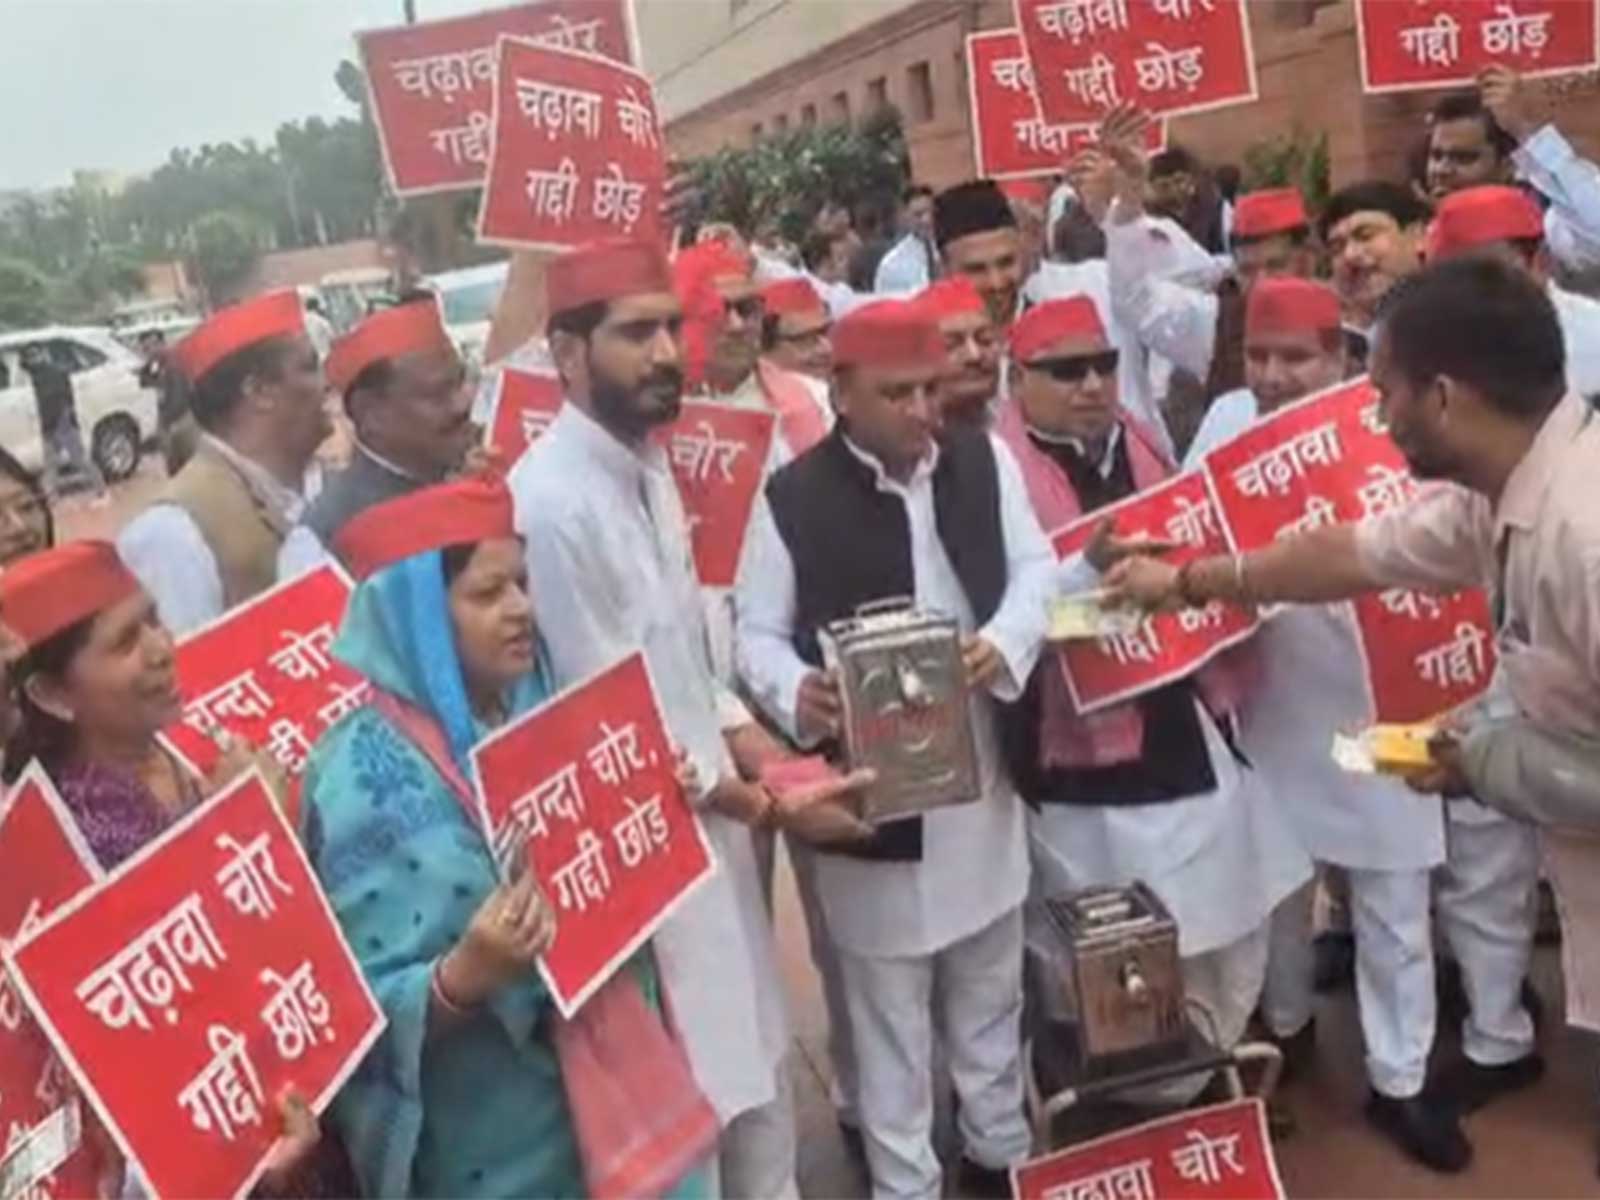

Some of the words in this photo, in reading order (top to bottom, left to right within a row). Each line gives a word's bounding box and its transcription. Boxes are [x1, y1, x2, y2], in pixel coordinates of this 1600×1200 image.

[1400, 13, 1461, 66] गद्दी
[1480, 4, 1552, 59] छोड़
[515, 78, 603, 141] चढ़ावा
[1064, 52, 1122, 109] गद्दी
[1134, 42, 1203, 92] छोड़
[526, 157, 579, 225] गद्दी
[592, 163, 645, 234] छोड़
[671, 420, 747, 483] चोर
[1232, 420, 1342, 495] चढ़ावा
[1415, 620, 1487, 690] गद्दी
[551, 830, 613, 912] गद्दी
[612, 794, 672, 869] छोड़
[74, 891, 227, 1032] चढ़ावा
[214, 832, 293, 919] चोर
[177, 1024, 265, 1142] गद्दी
[259, 959, 336, 1060] छोड़
[1172, 1129, 1246, 1185] चोर
